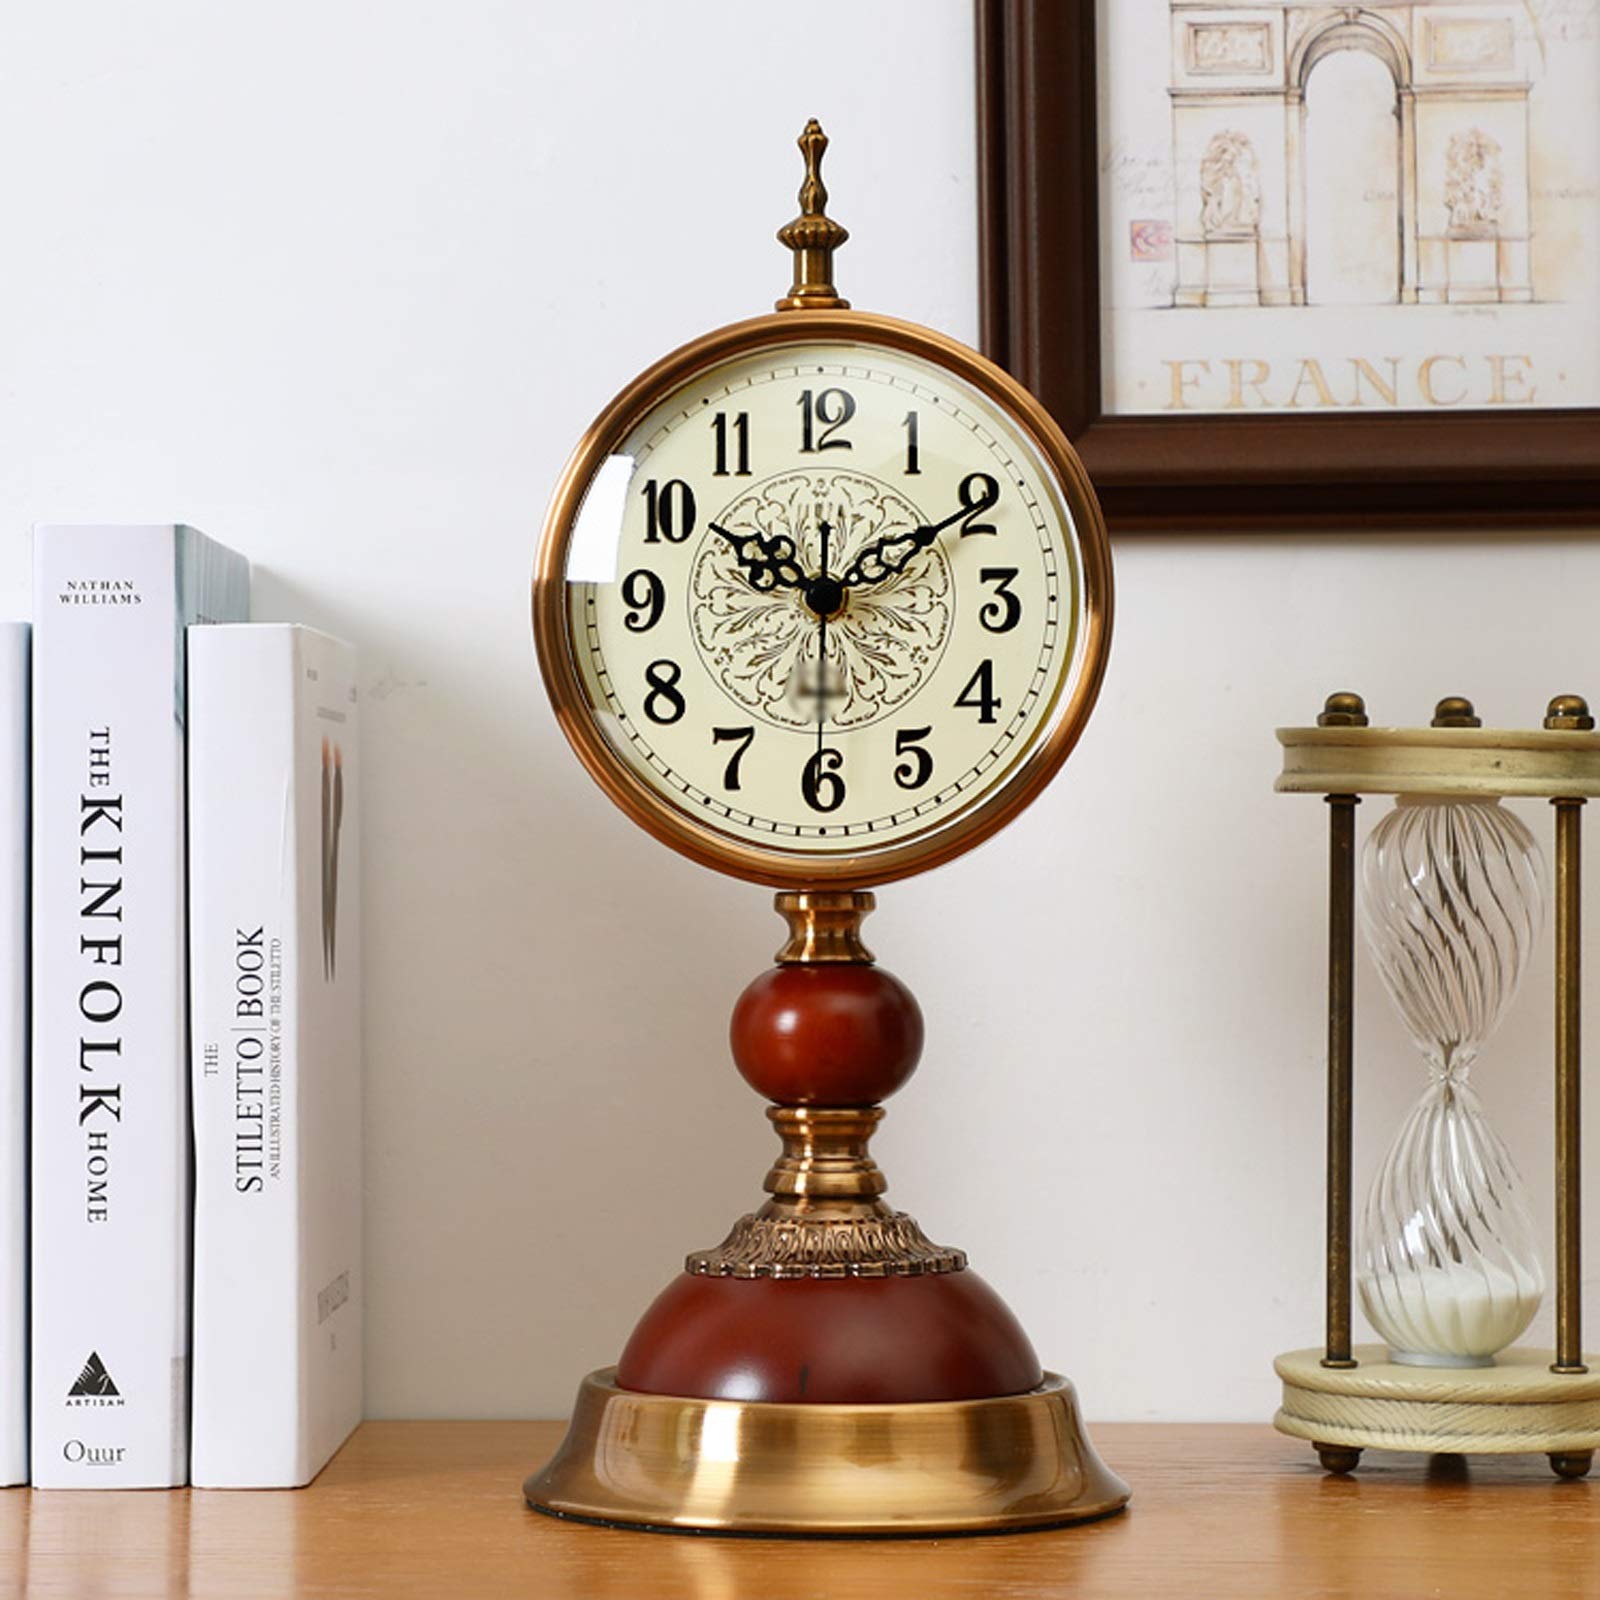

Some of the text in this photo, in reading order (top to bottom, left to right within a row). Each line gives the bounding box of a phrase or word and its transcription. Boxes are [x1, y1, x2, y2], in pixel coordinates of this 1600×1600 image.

[1161, 356, 1535, 409] FRANCE
[710, 412, 752, 477] 11
[797, 387, 856, 453] 12
[902, 411, 921, 475] 1
[642, 479, 696, 543] 10
[958, 473, 999, 538] 2
[59, 594, 142, 604] WILLIAMS
[67, 581, 133, 590] NATHAN
[622, 570, 665, 633] 9
[980, 568, 1021, 633] 3
[644, 660, 685, 725] 8
[954, 659, 1001, 723] 4
[713, 727, 754, 790] 7
[802, 748, 845, 813] 6
[894, 726, 933, 789] 5
[79, 727, 122, 1223] THE KINFOLK HOME
[204, 1042, 218, 1077] THE
[235, 926, 264, 1193] STILETTO BOOK
[269, 1034, 282, 1083] HISTORY
[63, 1440, 126, 1462] Ouur
